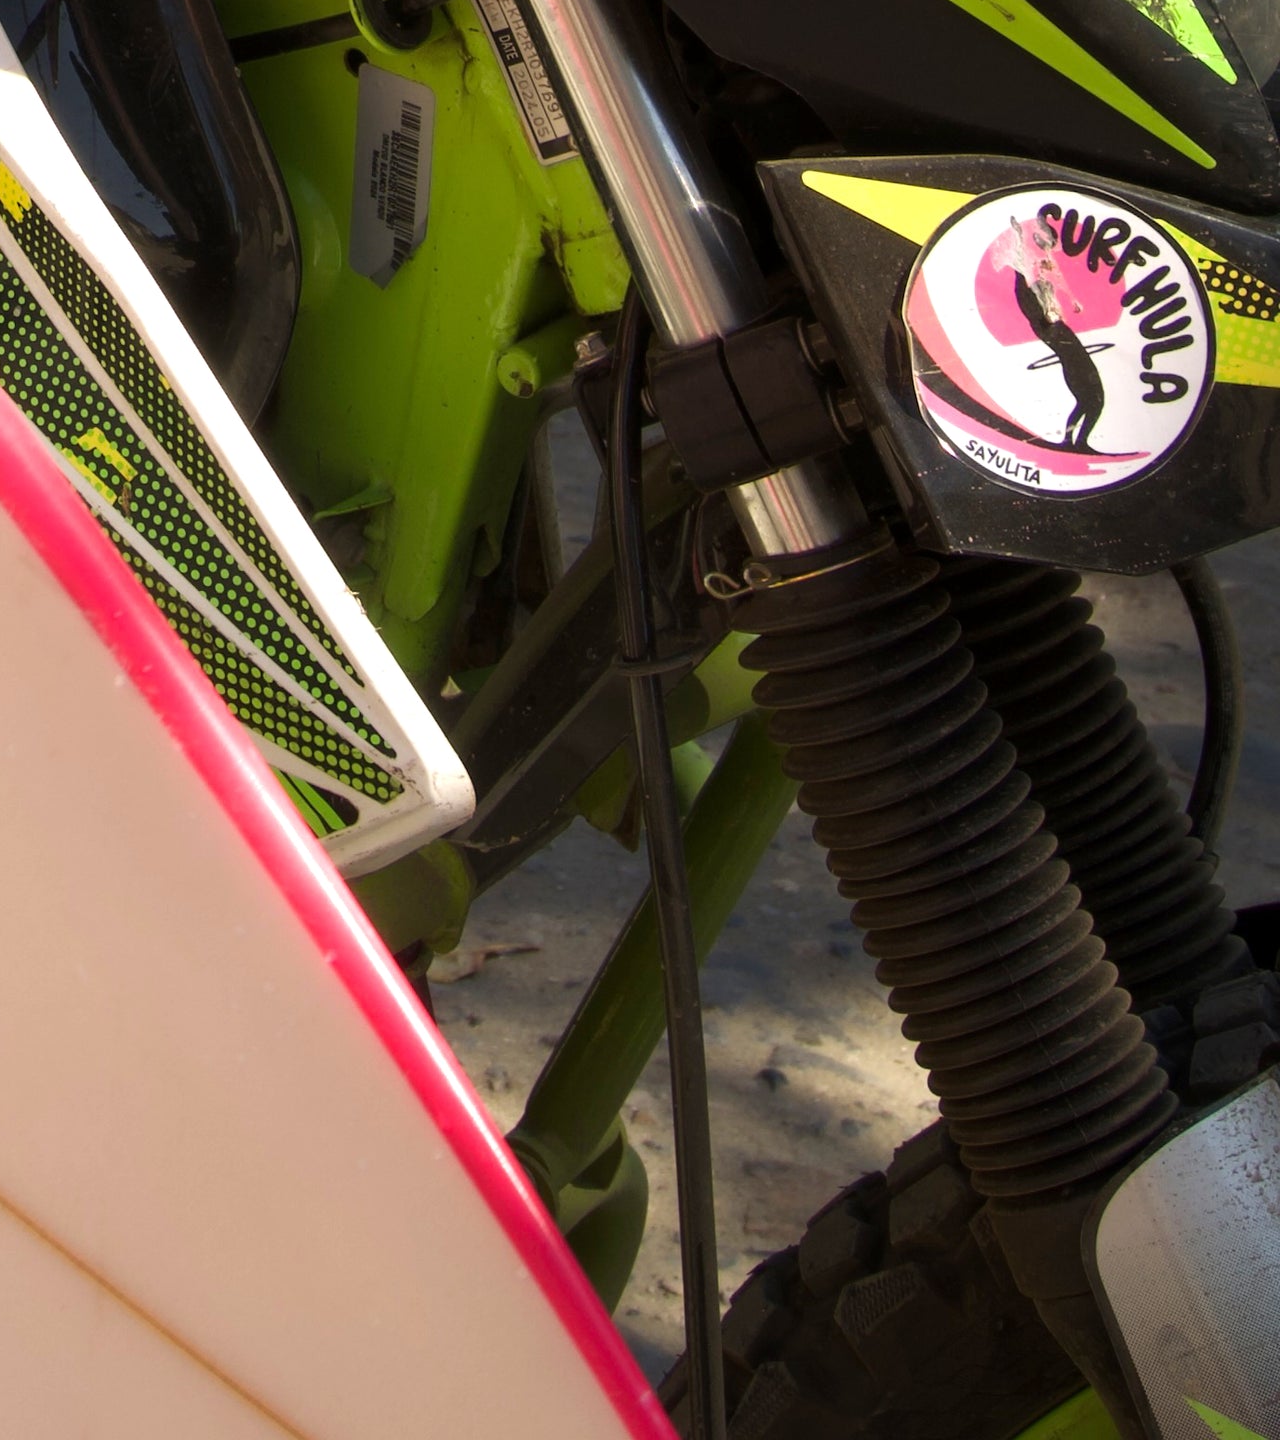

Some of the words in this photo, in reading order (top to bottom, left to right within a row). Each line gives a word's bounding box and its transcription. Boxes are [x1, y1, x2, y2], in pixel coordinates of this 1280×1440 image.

[498, 32, 520, 62] DATE
[513, 67, 551, 140] 2024.05
[965, 438, 1042, 486] SAYULITA
